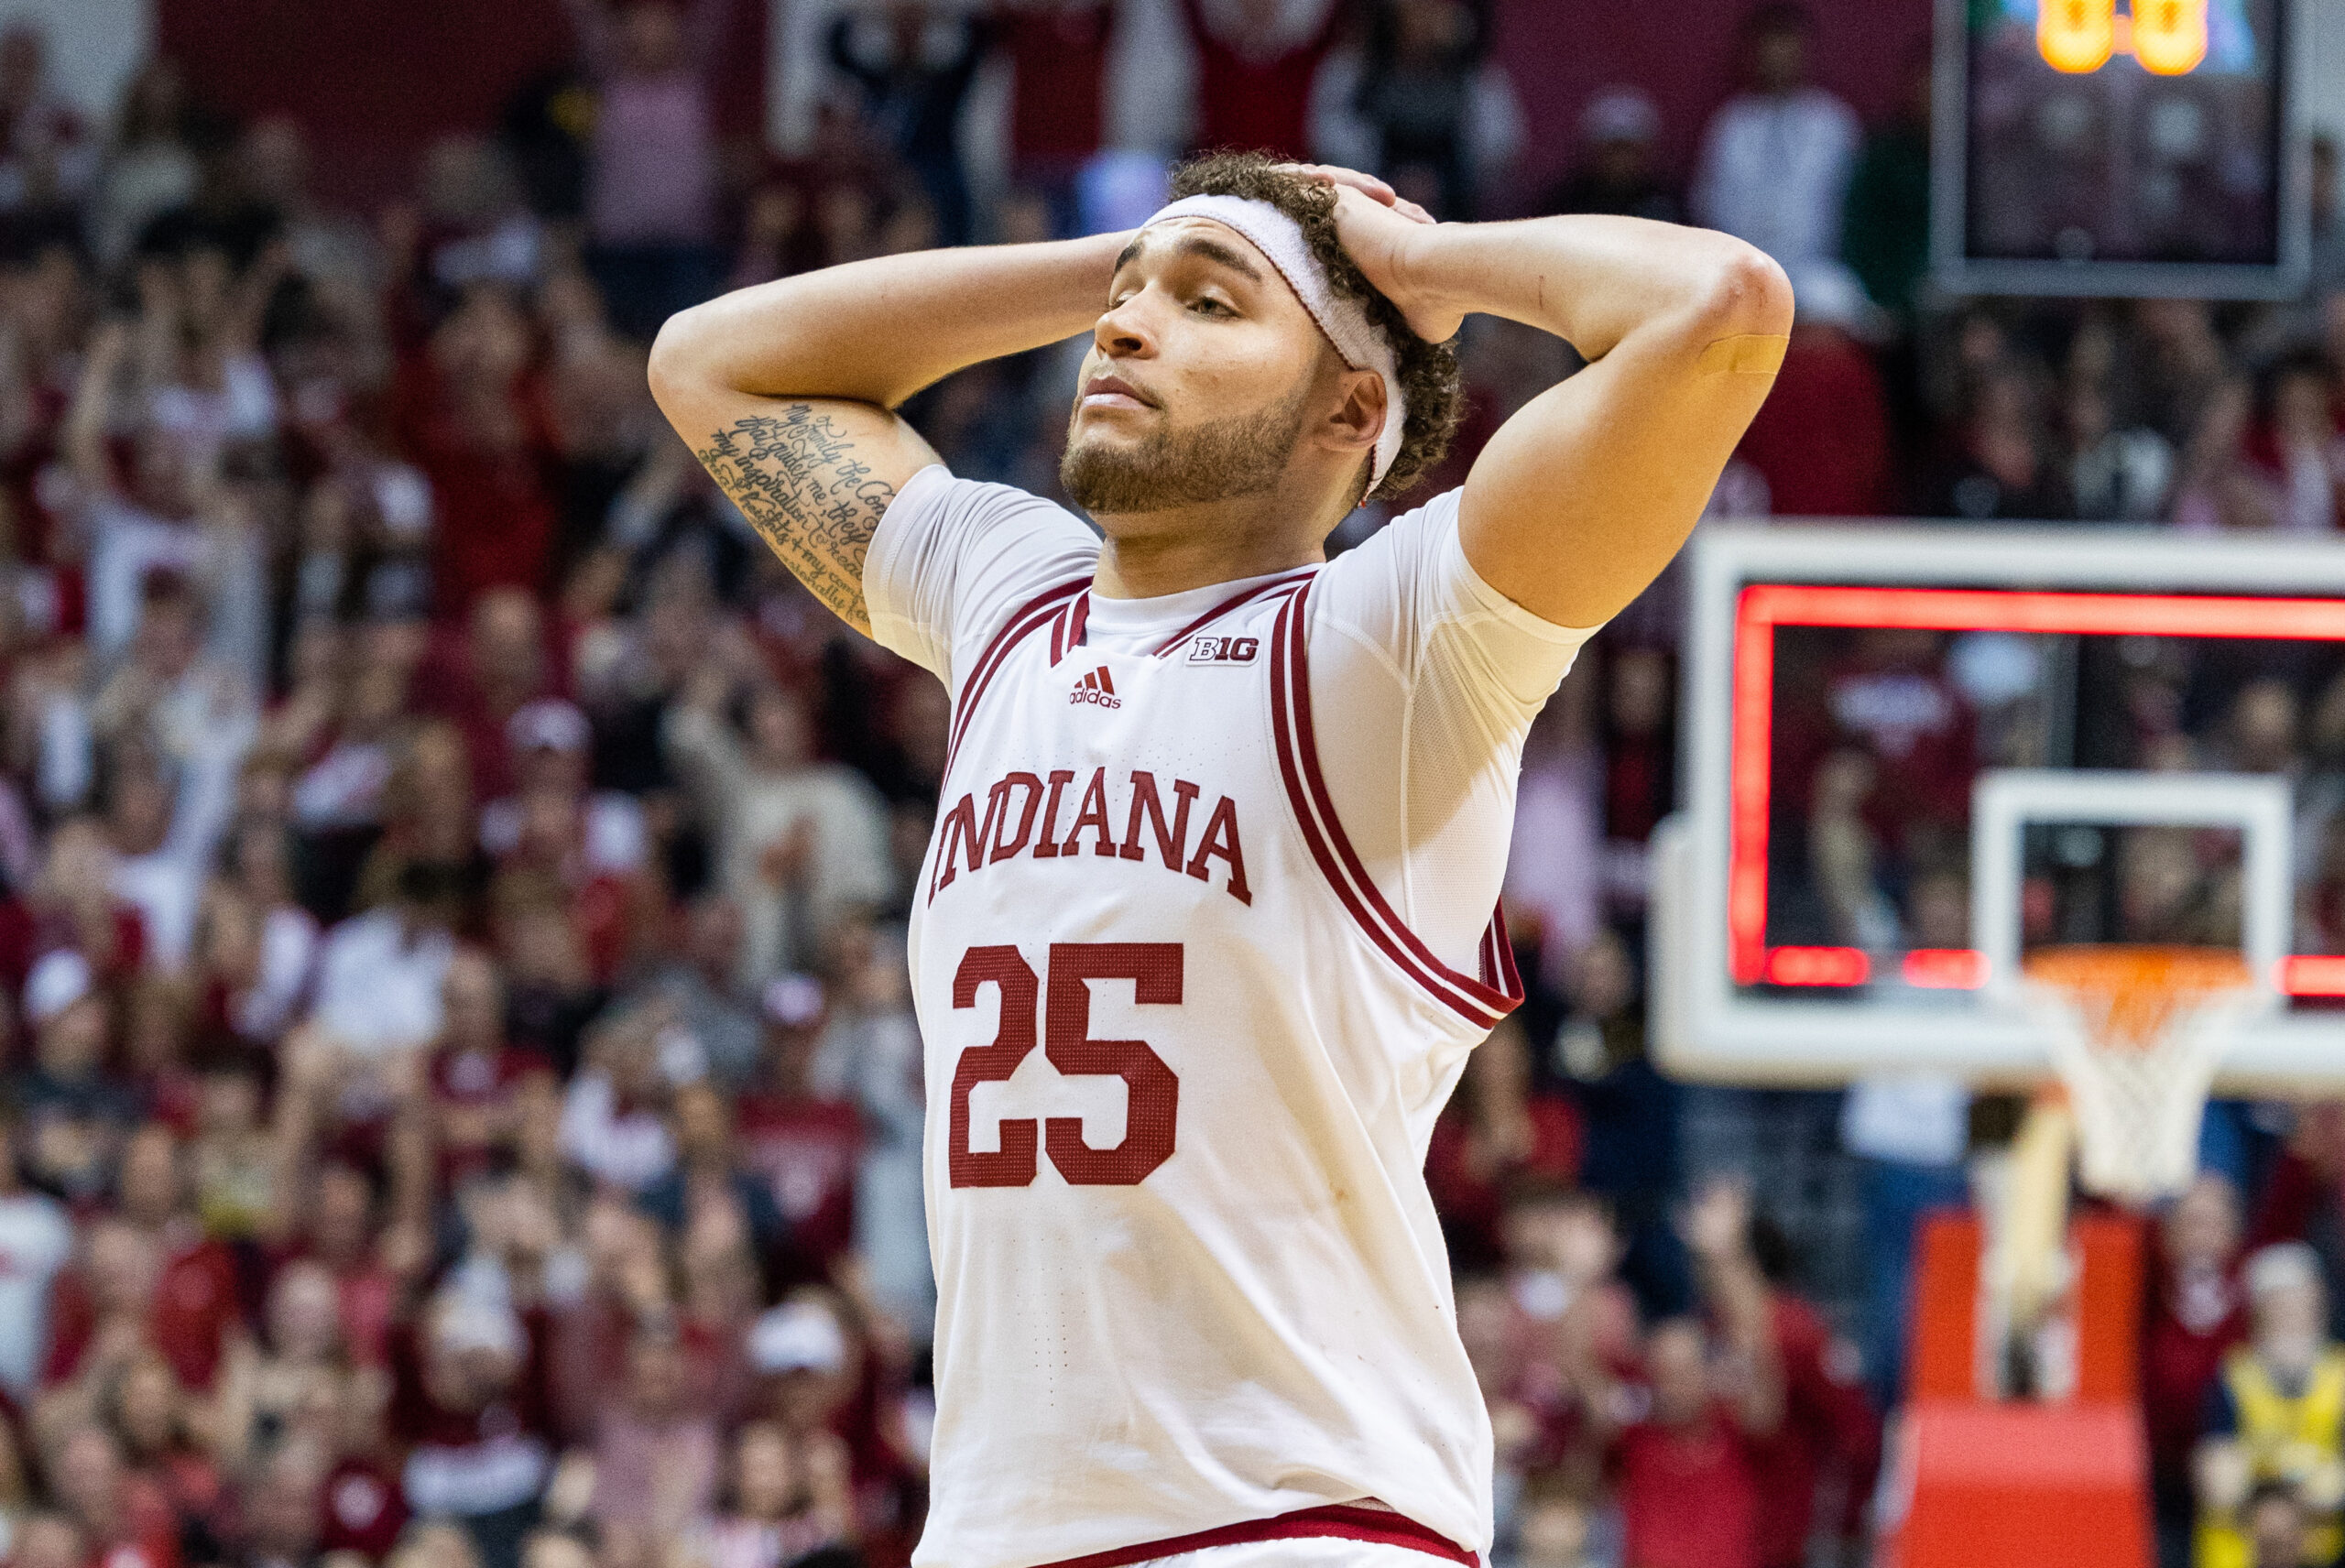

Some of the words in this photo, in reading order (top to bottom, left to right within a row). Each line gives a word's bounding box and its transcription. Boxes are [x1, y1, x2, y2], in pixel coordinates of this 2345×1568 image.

[728, 415, 786, 447] that
[830, 459, 871, 495] the
[856, 481, 898, 516] Com
[826, 541, 865, 582] reac
[1069, 689, 1121, 710] adidas
[927, 767, 1253, 909] INDIANA
[949, 942, 1183, 1189] 25
